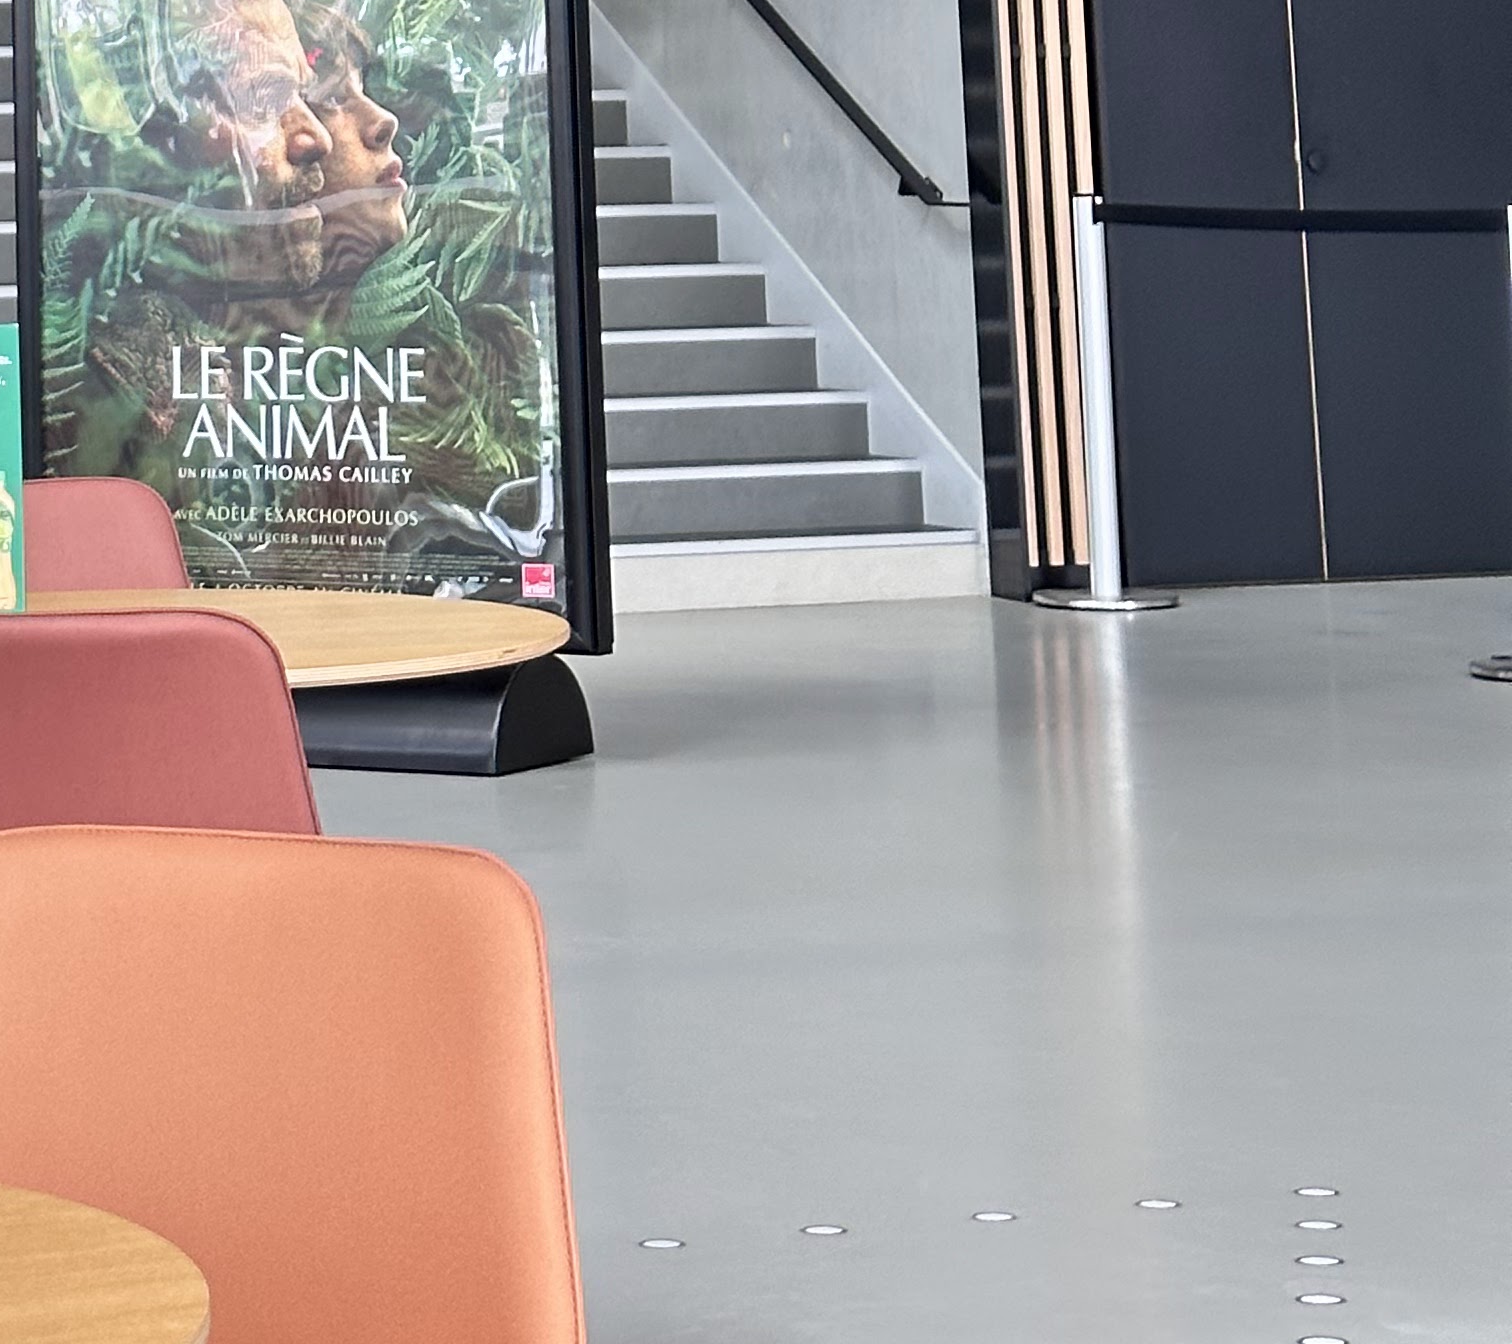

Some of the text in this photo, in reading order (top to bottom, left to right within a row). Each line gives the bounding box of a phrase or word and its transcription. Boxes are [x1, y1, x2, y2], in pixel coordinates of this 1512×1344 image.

[172, 332, 427, 403] LE RÈGNE
[182, 402, 406, 462] ANIMAL
[178, 464, 413, 484] UN FILM DE THOMAS CAILLEY
[175, 502, 419, 527] AVEC ADÈLE EXARCHOPOULOS
[247, 532, 299, 545] MERCIER
[310, 534, 346, 546] BILLIE
[350, 534, 387, 547] BLAIN
